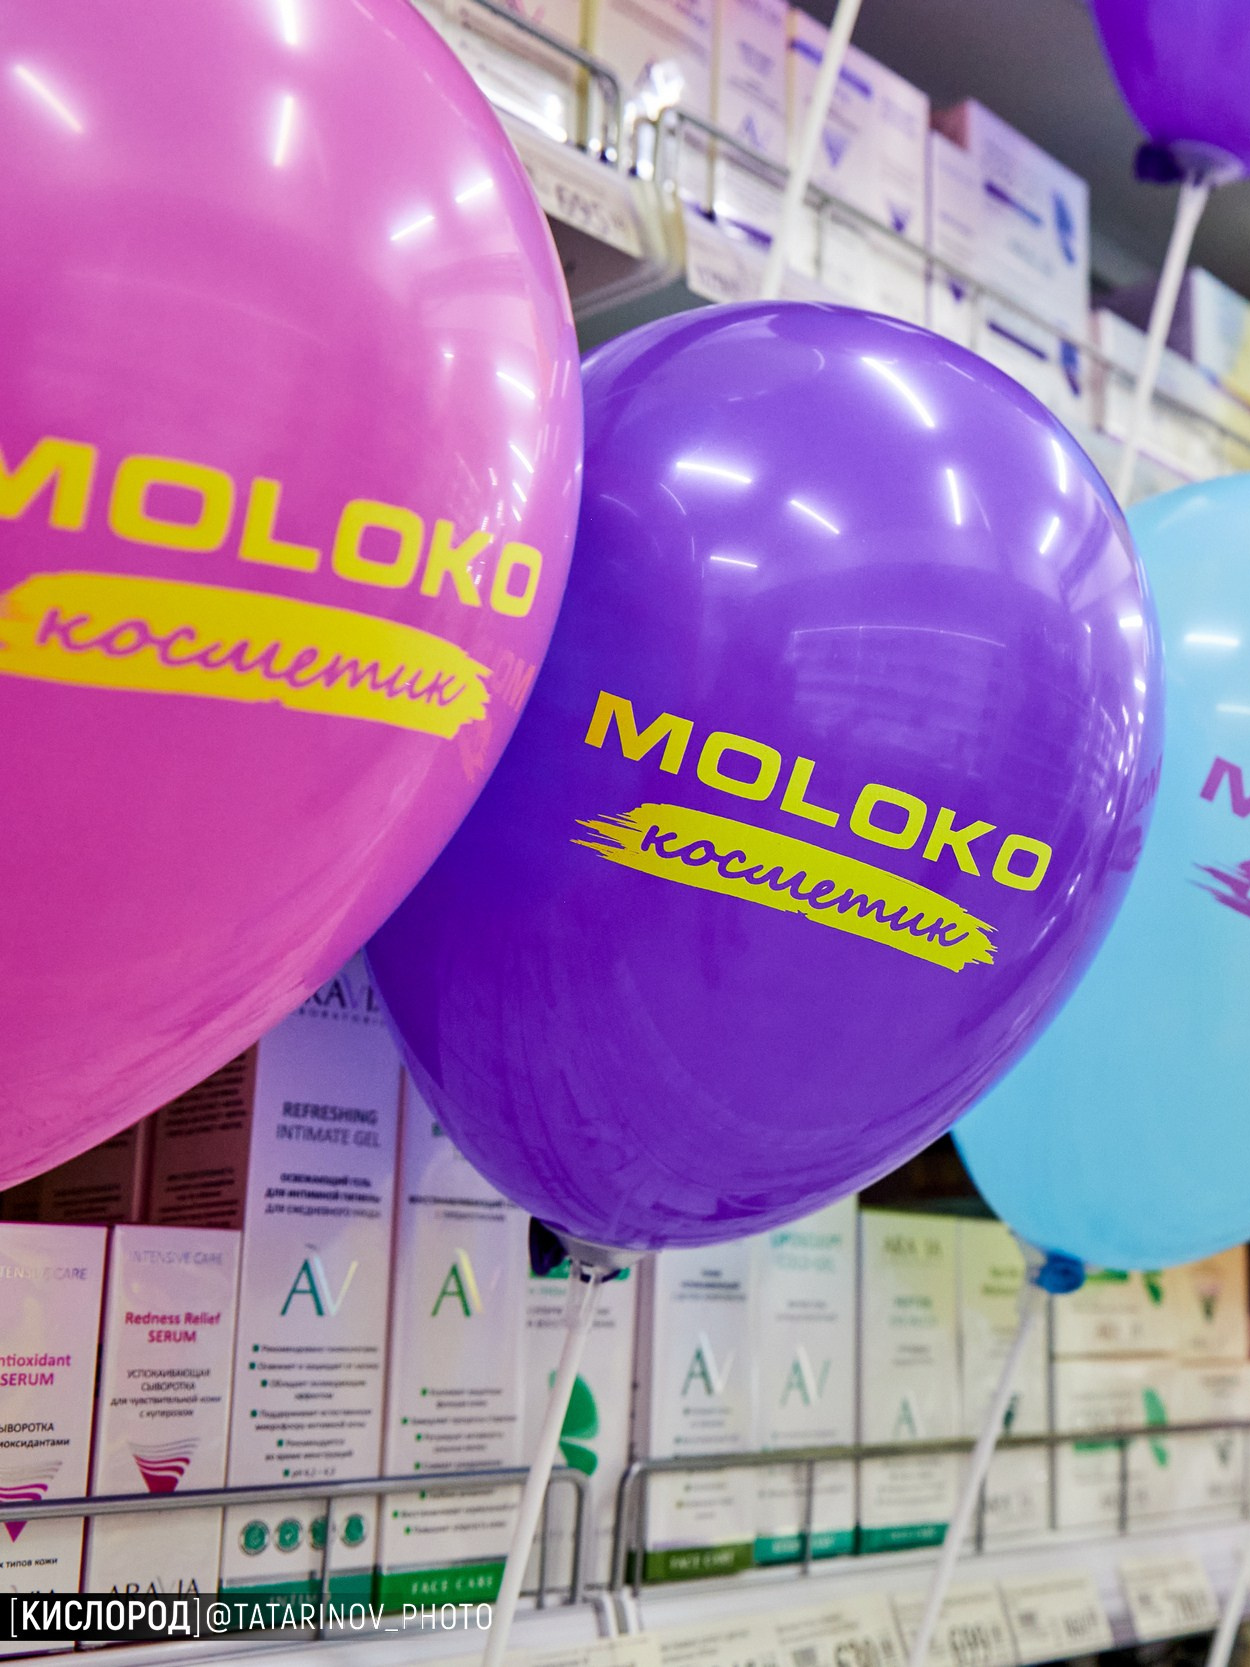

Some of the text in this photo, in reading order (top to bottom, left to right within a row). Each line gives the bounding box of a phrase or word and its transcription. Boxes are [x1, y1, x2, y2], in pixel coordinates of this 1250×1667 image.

[0, 436, 543, 618] MOLOKO
[35, 607, 467, 708] косметик
[584, 689, 1053, 892] MOLOKO
[640, 825, 970, 948] косметик
[282, 1101, 379, 1126] REFRESHING
[276, 1124, 382, 1148] INTIMATE GEL
[53, 1267, 88, 1281] CARE
[125, 1311, 222, 1326] Redness Relief
[147, 1329, 197, 1344] SERUM
[0, 1371, 54, 1387] SERUM
[141, 1381, 196, 1392] СЫВОРОТКА
[6, 1559, 32, 1568] типов
[34, 1557, 58, 1566] кожи
